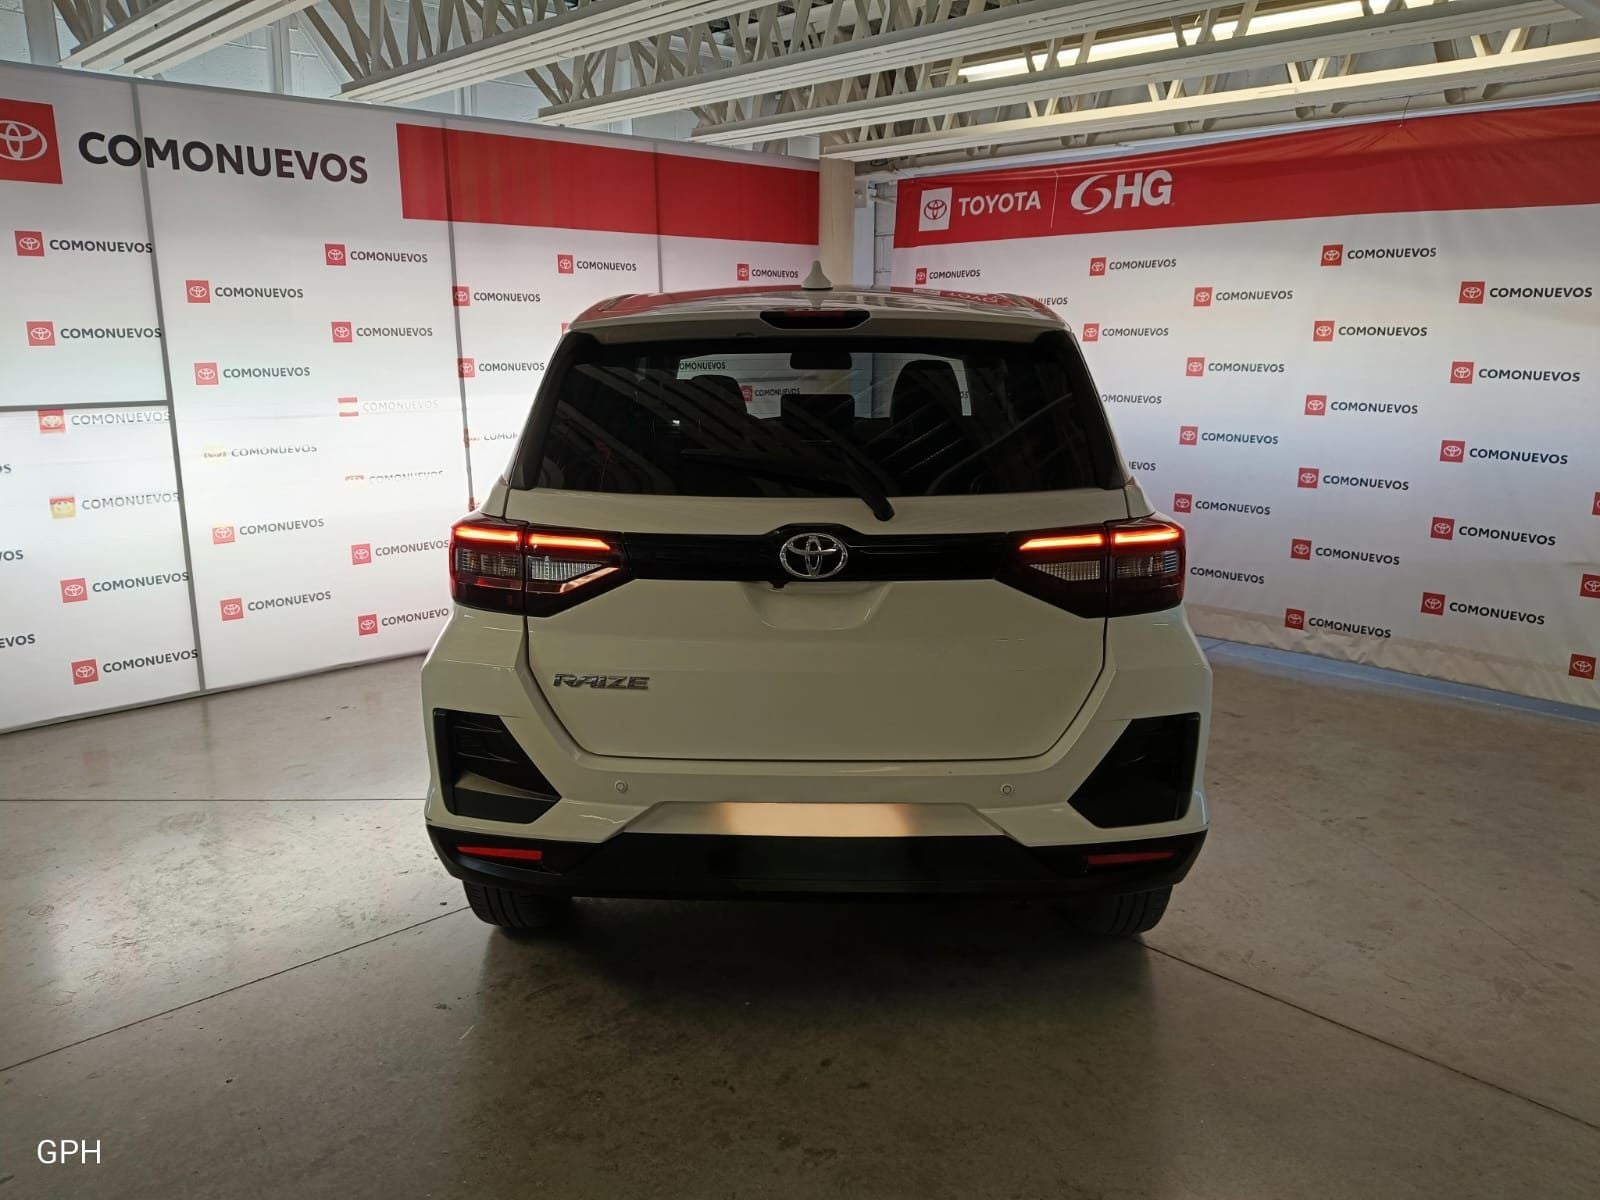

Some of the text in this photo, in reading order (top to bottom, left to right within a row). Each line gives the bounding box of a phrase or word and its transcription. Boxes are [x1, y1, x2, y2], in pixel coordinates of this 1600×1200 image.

[78, 131, 369, 184] COMONUEVOS
[959, 190, 1041, 217] TOYOTA
[49, 238, 153, 254] COMONUEVOS
[1347, 247, 1437, 259] COMONUEVOS
[350, 250, 428, 263] COMONUEVOS
[577, 260, 636, 272] COMONUEVOS
[1109, 259, 1177, 270] COMONUEVOS
[752, 268, 799, 279] COMONUEVOS
[929, 269, 981, 280] COMONUEVOS
[215, 286, 304, 299] COMONUEVOS
[473, 291, 541, 302] COMONUEVOS
[1216, 290, 1293, 301] COMONUEVOS
[1489, 287, 1593, 298] COMONUEVOS
[60, 327, 162, 340] COMONUEVOS
[356, 326, 433, 338] COMONUEVOS
[1102, 327, 1169, 337] COMONUEVOS
[1338, 326, 1428, 337] COMONUEVOS
[223, 366, 311, 379] COMONUEVOS
[479, 362, 545, 372] COMONUEVOS
[1208, 363, 1285, 372] COMONUEVOS
[1478, 369, 1581, 383] COMONUEVOS
[362, 399, 439, 412] COMONUEVOS
[1330, 401, 1419, 415] COMONUEVOS
[71, 411, 171, 426] COMONUEVOS
[1202, 432, 1279, 445] COMONUEVOS
[1469, 448, 1569, 465] COMONUEVOS
[1322, 475, 1409, 491] COMONUEVOS
[81, 492, 180, 510] COMONUEVOS
[1195, 500, 1271, 515] COMONUEVOS
[239, 518, 325, 536] COMONUEVOS
[1459, 525, 1556, 546] COMONUEVOS
[375, 539, 449, 557] COMONUEVOS
[1315, 547, 1400, 566] COMONUEVOS
[92, 571, 190, 593] COMONUEVOS
[1190, 566, 1265, 585] COMONUEVOS
[247, 591, 332, 611] COMONUEVOS
[1449, 601, 1545, 625] COMONUEVOS
[1308, 617, 1392, 639] COMONUEVOS
[103, 649, 198, 673] COMONUEVOS
[553, 673, 650, 690] RAIZE
